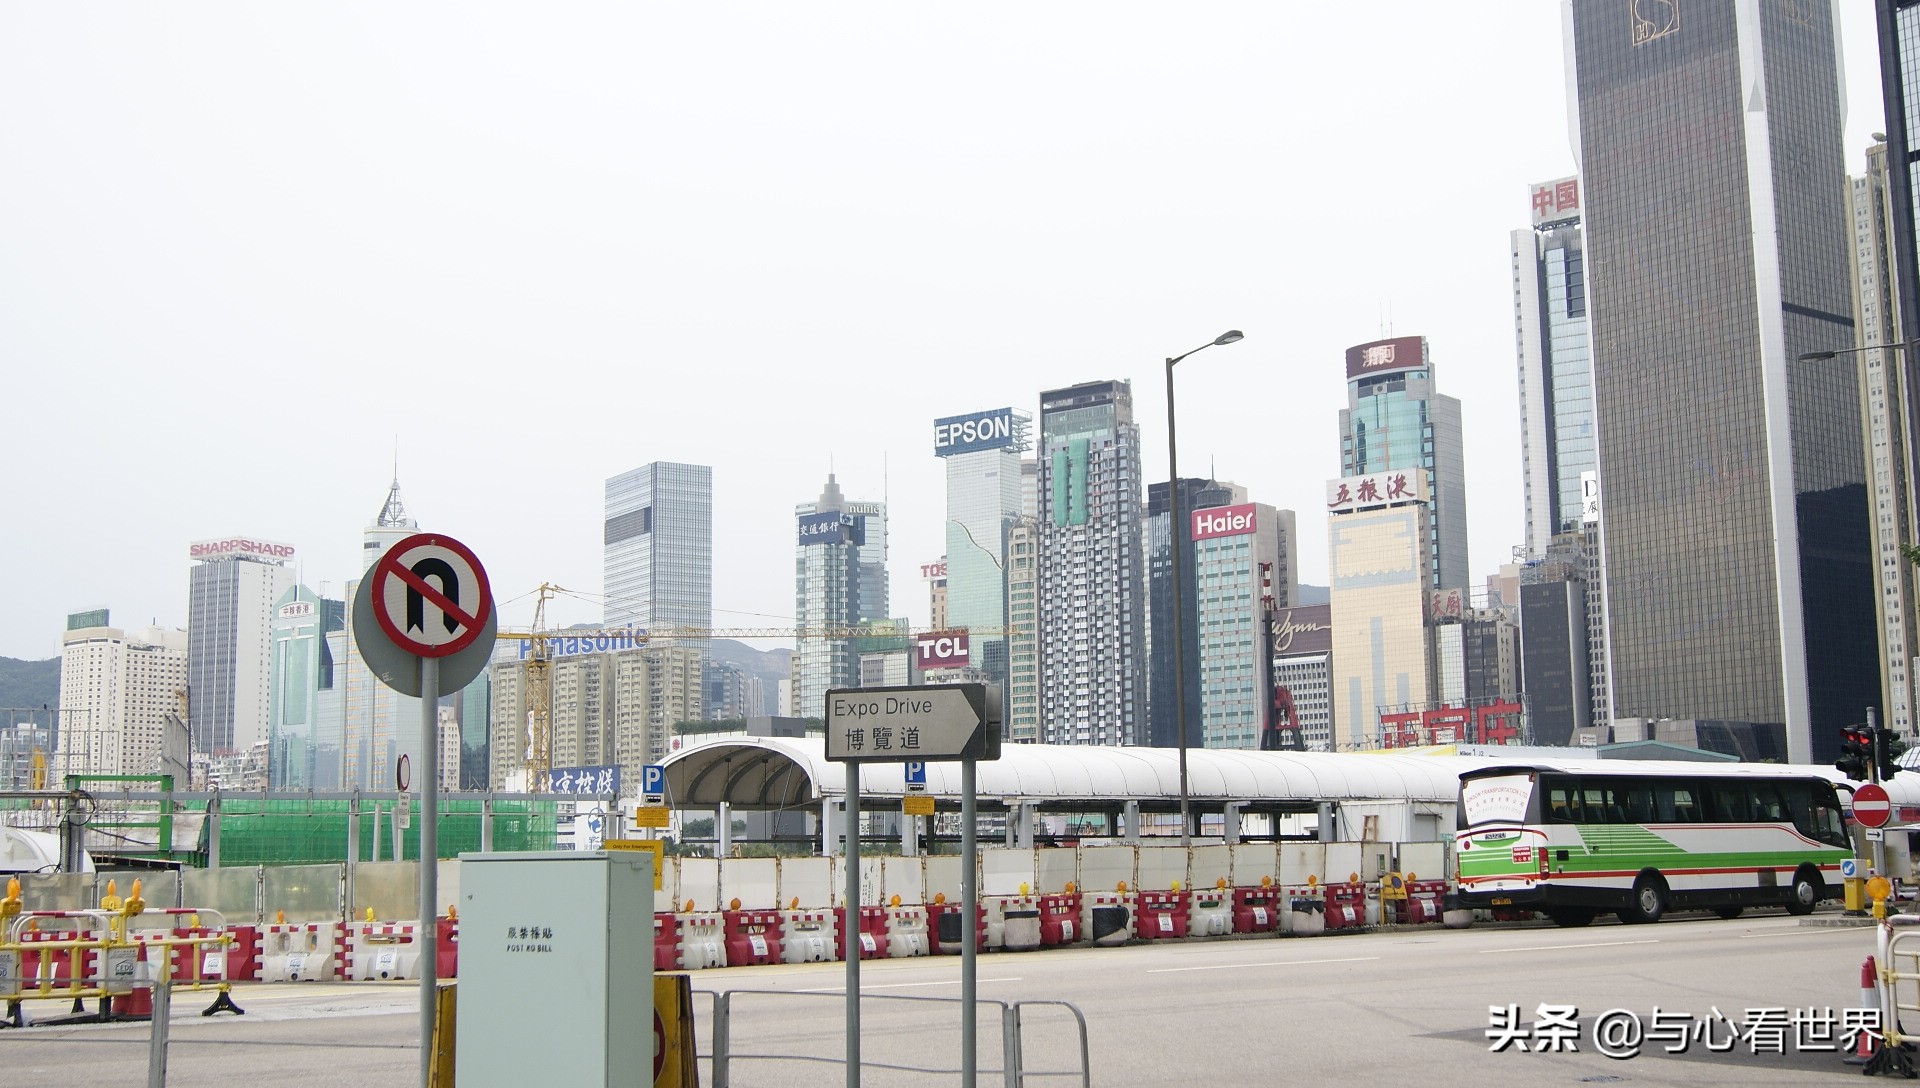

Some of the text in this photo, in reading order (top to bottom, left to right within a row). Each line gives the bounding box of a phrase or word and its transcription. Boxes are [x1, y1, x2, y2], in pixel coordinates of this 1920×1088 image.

[1532, 179, 1579, 217] 中国
[936, 415, 1009, 447] EPSON
[800, 521, 840, 536] 交通銀行
[1197, 511, 1254, 535] Haier
[190, 539, 295, 557] SHARP SHARP
[519, 622, 649, 660] Pnasonic
[919, 637, 967, 659] TCL
[834, 697, 932, 719] Expo Drive
[845, 726, 921, 751] 博覽道
[646, 768, 661, 791] P
[1481, 787, 1519, 796] TRANSPORTATION
[507, 944, 524, 952] POST
